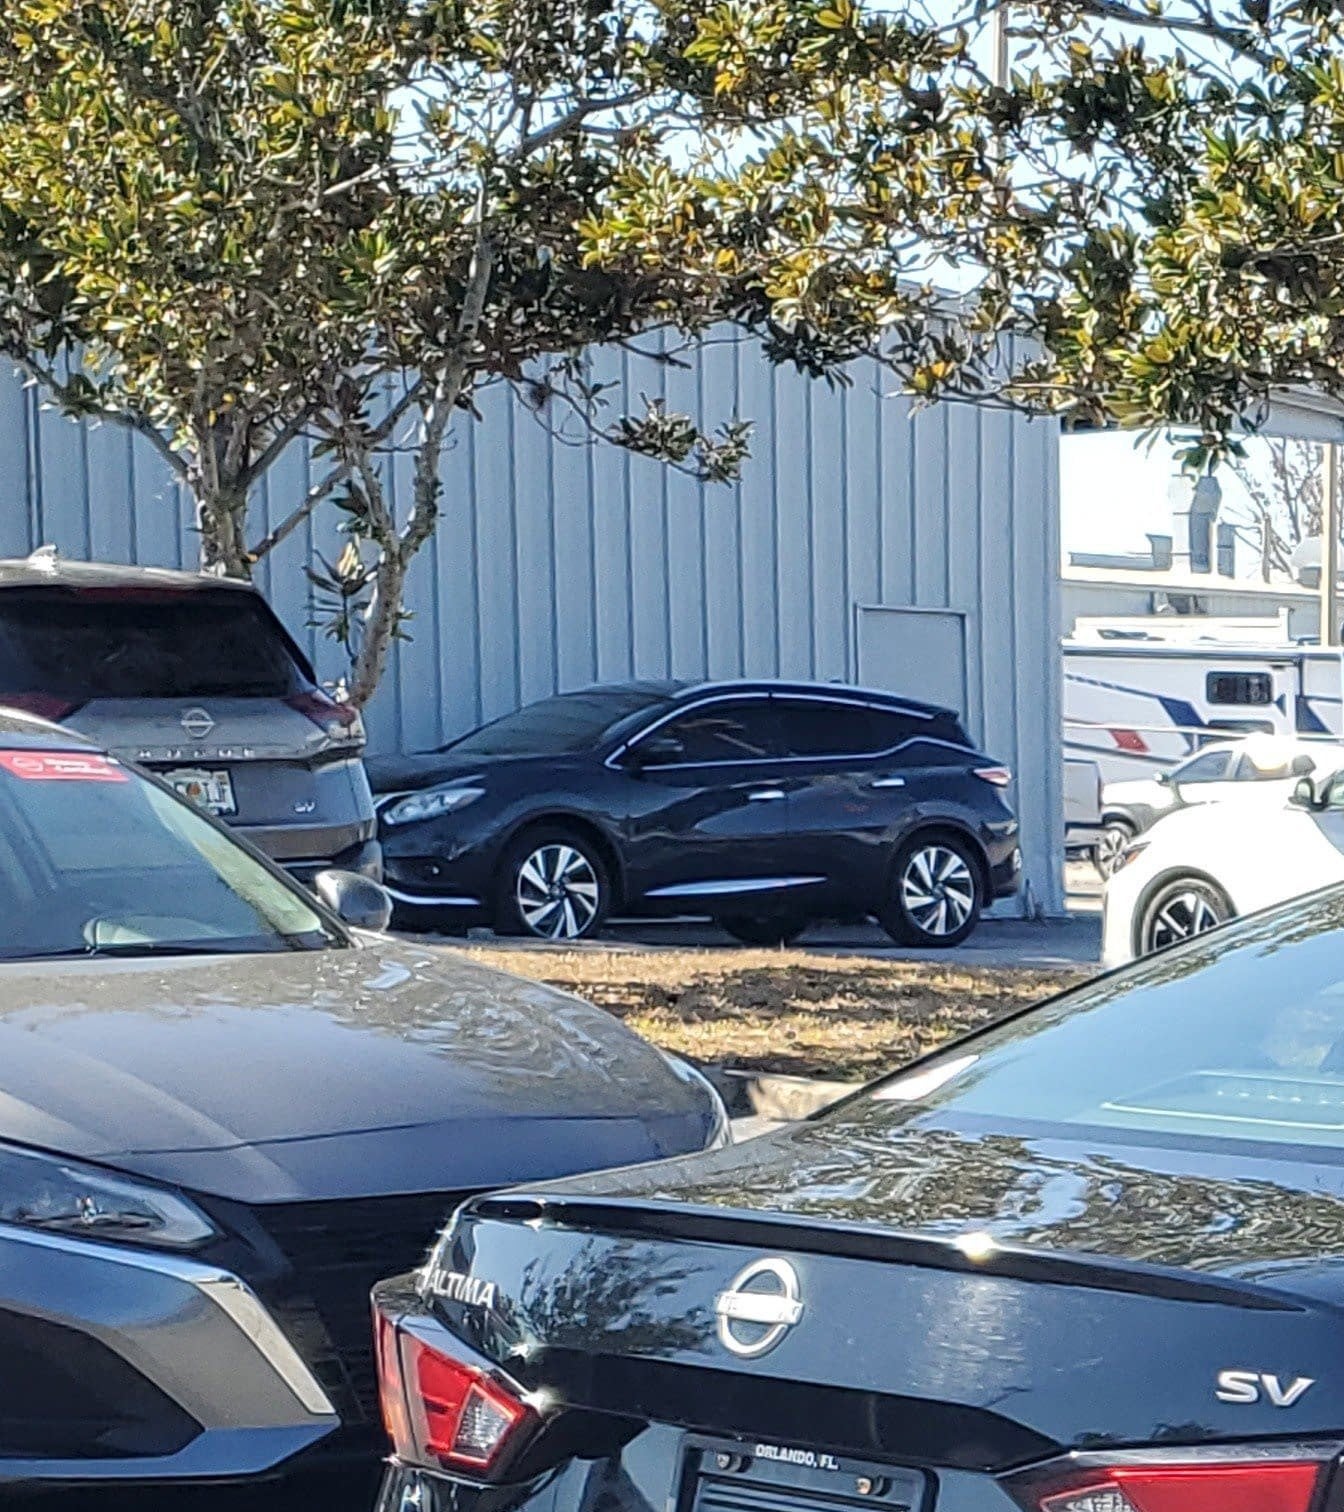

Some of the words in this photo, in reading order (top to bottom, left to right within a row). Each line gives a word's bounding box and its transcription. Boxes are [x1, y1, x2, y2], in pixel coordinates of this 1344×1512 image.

[426, 1267, 496, 1309] ALTIMA
[1215, 1371, 1317, 1407] SV
[755, 1443, 818, 1468] ORLANDO,
